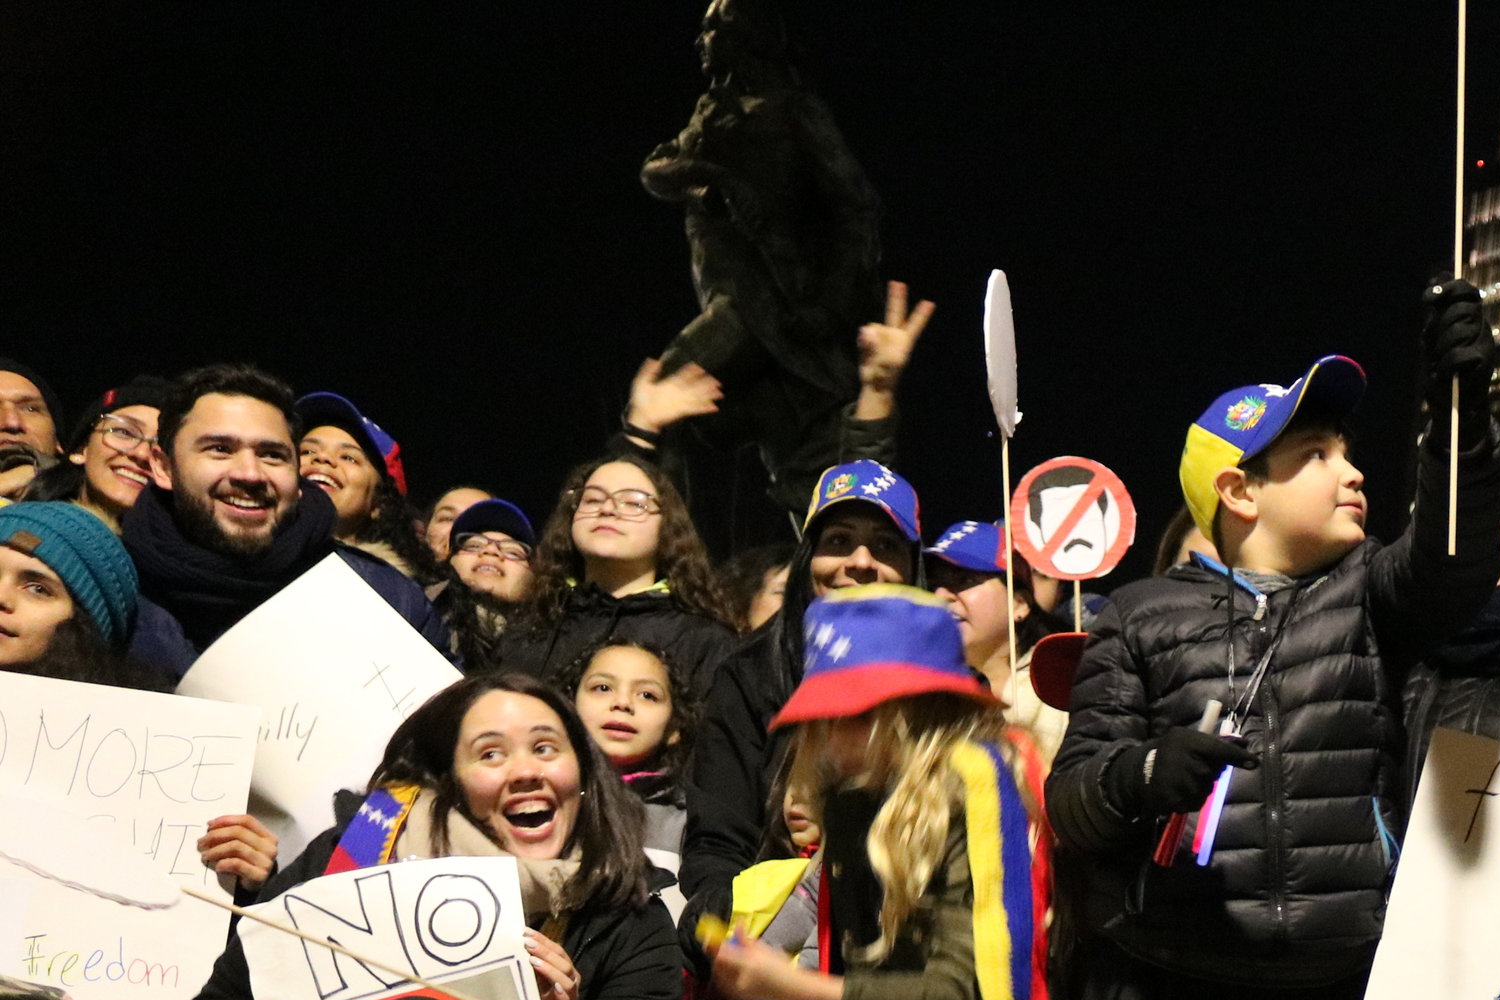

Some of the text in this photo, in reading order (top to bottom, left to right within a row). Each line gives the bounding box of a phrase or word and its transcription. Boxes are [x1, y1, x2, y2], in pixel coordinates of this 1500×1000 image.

[24, 708, 242, 804] MORE
[22, 934, 179, 988] Freedom
[285, 871, 501, 1000] NO
